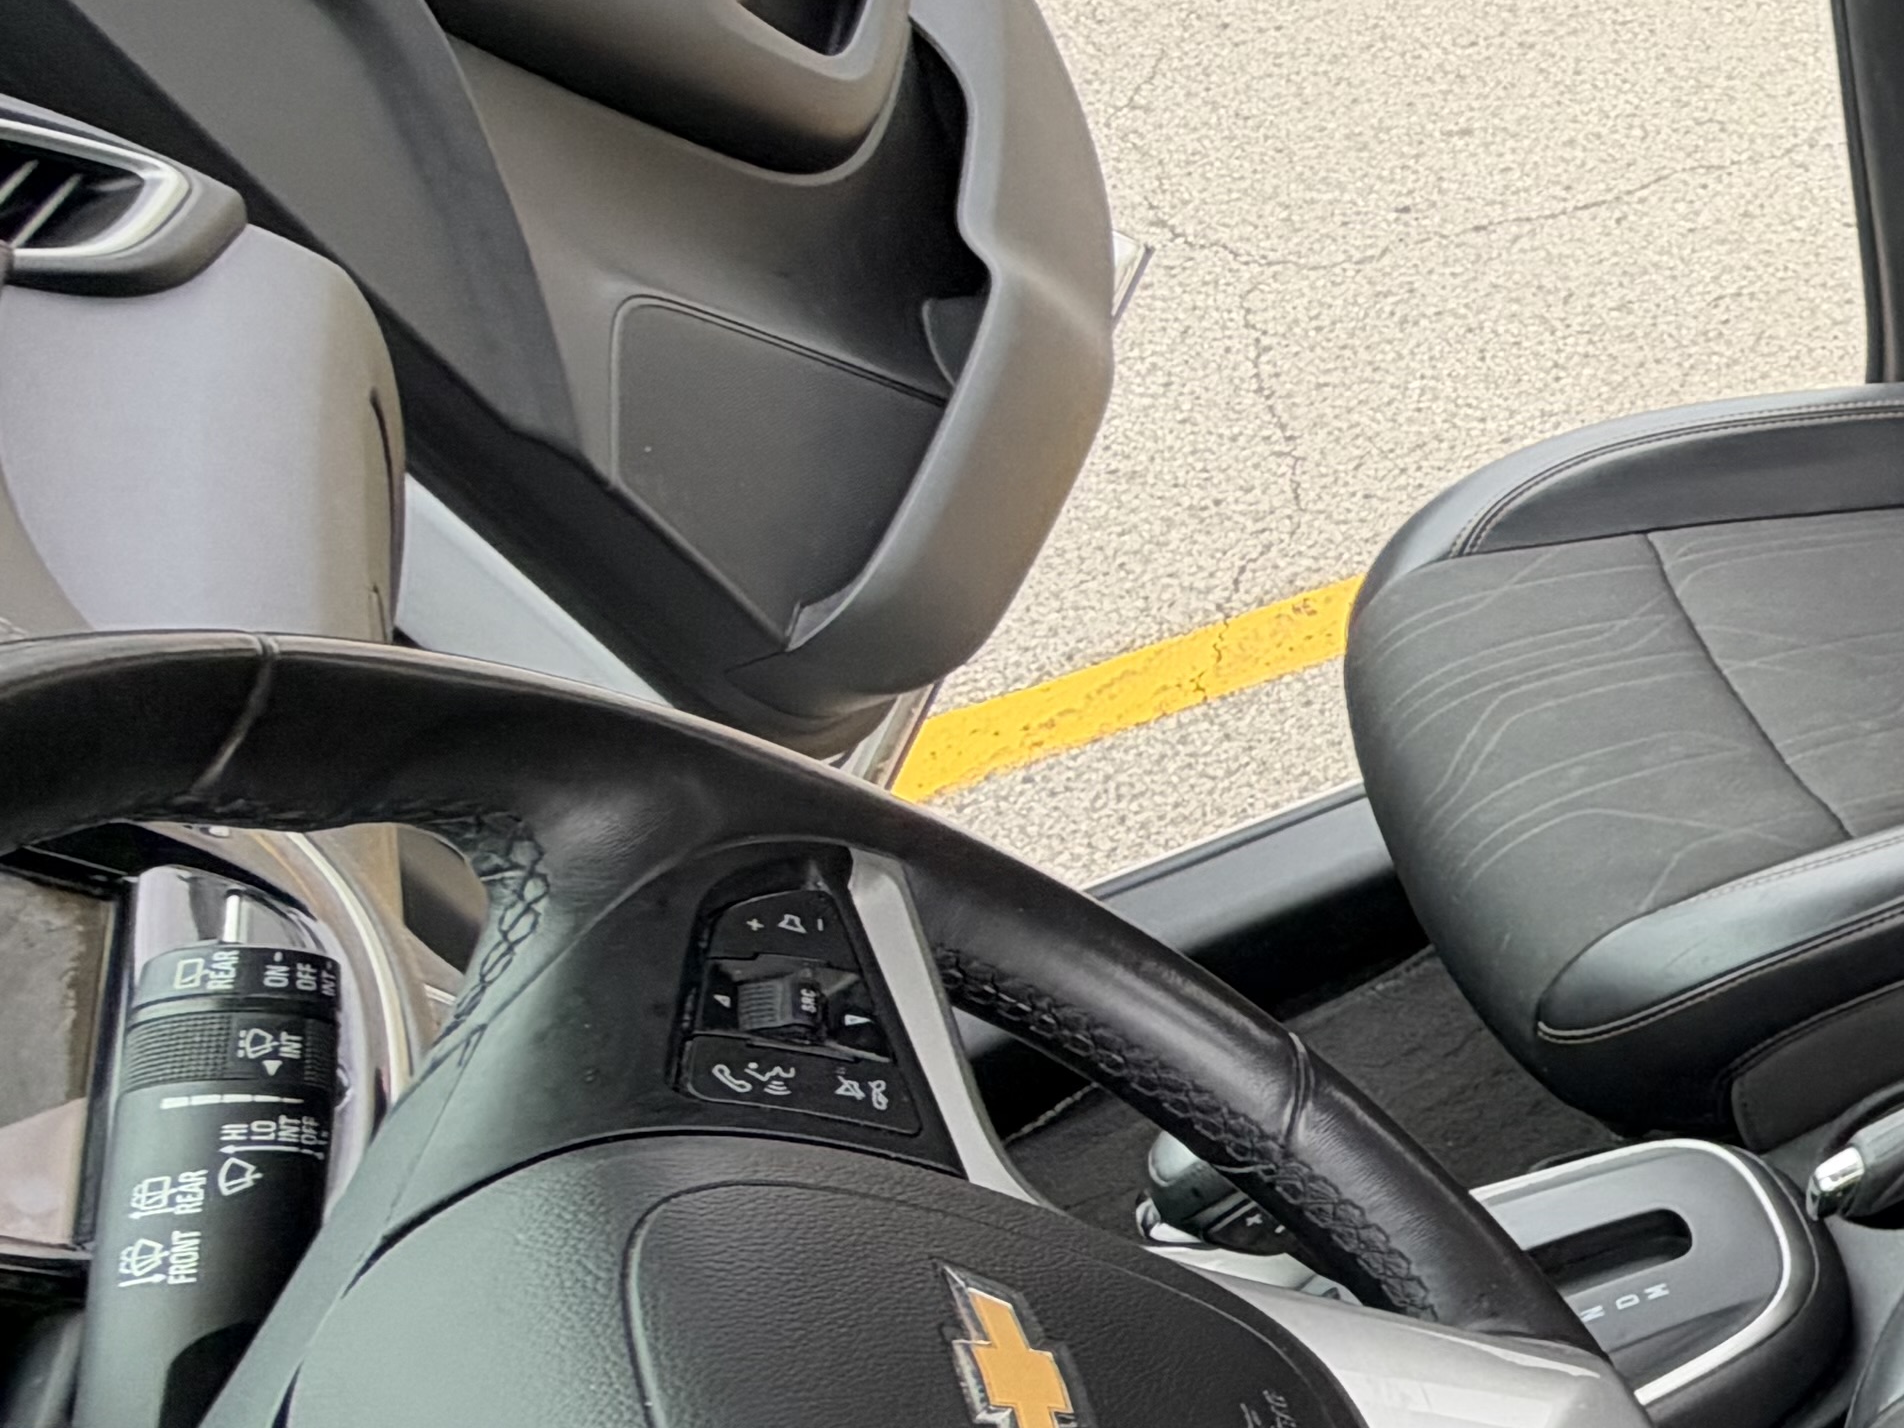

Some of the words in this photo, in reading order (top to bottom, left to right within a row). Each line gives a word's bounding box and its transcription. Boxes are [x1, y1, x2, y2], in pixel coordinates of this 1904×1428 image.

[206, 950, 239, 990] REAR
[263, 965, 289, 987] ON
[296, 962, 318, 991] OFF
[321, 972, 338, 998] INT
[279, 1031, 303, 1059] INT
[220, 1123, 248, 1141] HI
[250, 1120, 276, 1141] LO
[278, 1115, 302, 1142] INT
[301, 1116, 319, 1145] OFF
[173, 1169, 209, 1215] REAR
[166, 1230, 202, 1285] FRONT
[1580, 1305, 1605, 1323] N
[1615, 1293, 1640, 1310] D
